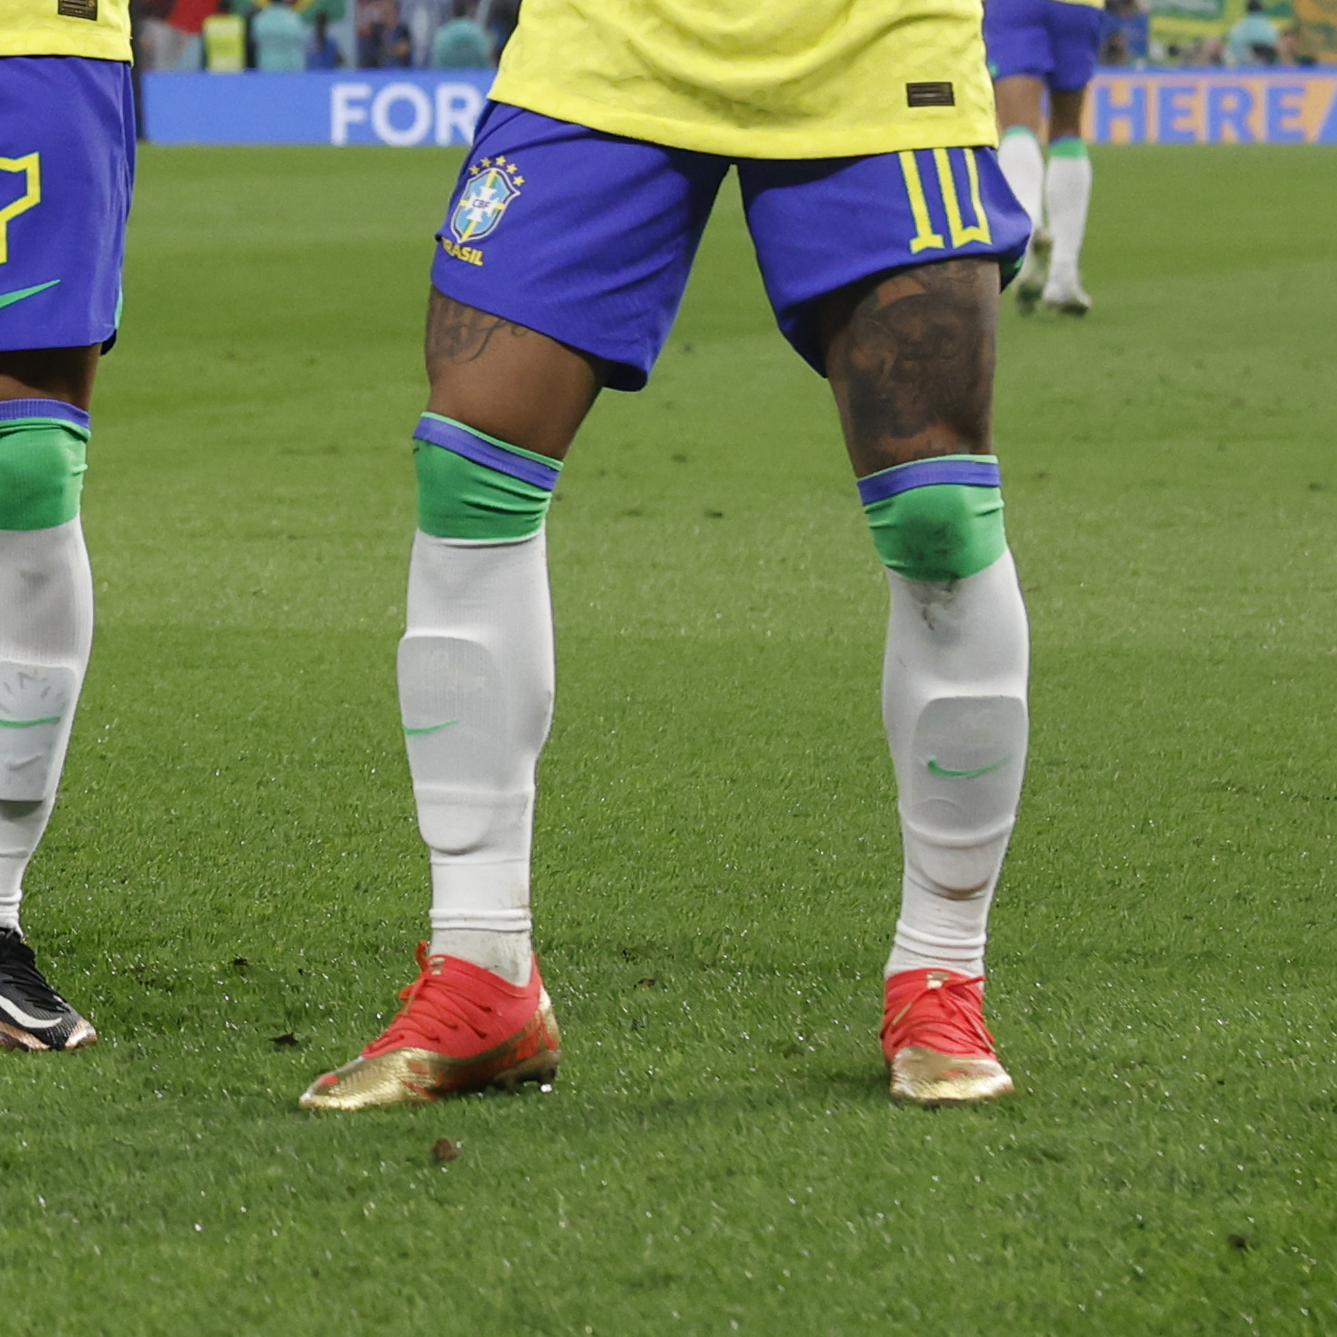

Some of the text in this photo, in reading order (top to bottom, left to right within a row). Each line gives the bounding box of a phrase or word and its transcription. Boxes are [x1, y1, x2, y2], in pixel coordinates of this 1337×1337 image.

[330, 82, 484, 147] FOR
[1096, 86, 1305, 143] HERE
[472, 199, 491, 209] CBF
[898, 147, 993, 255] 10
